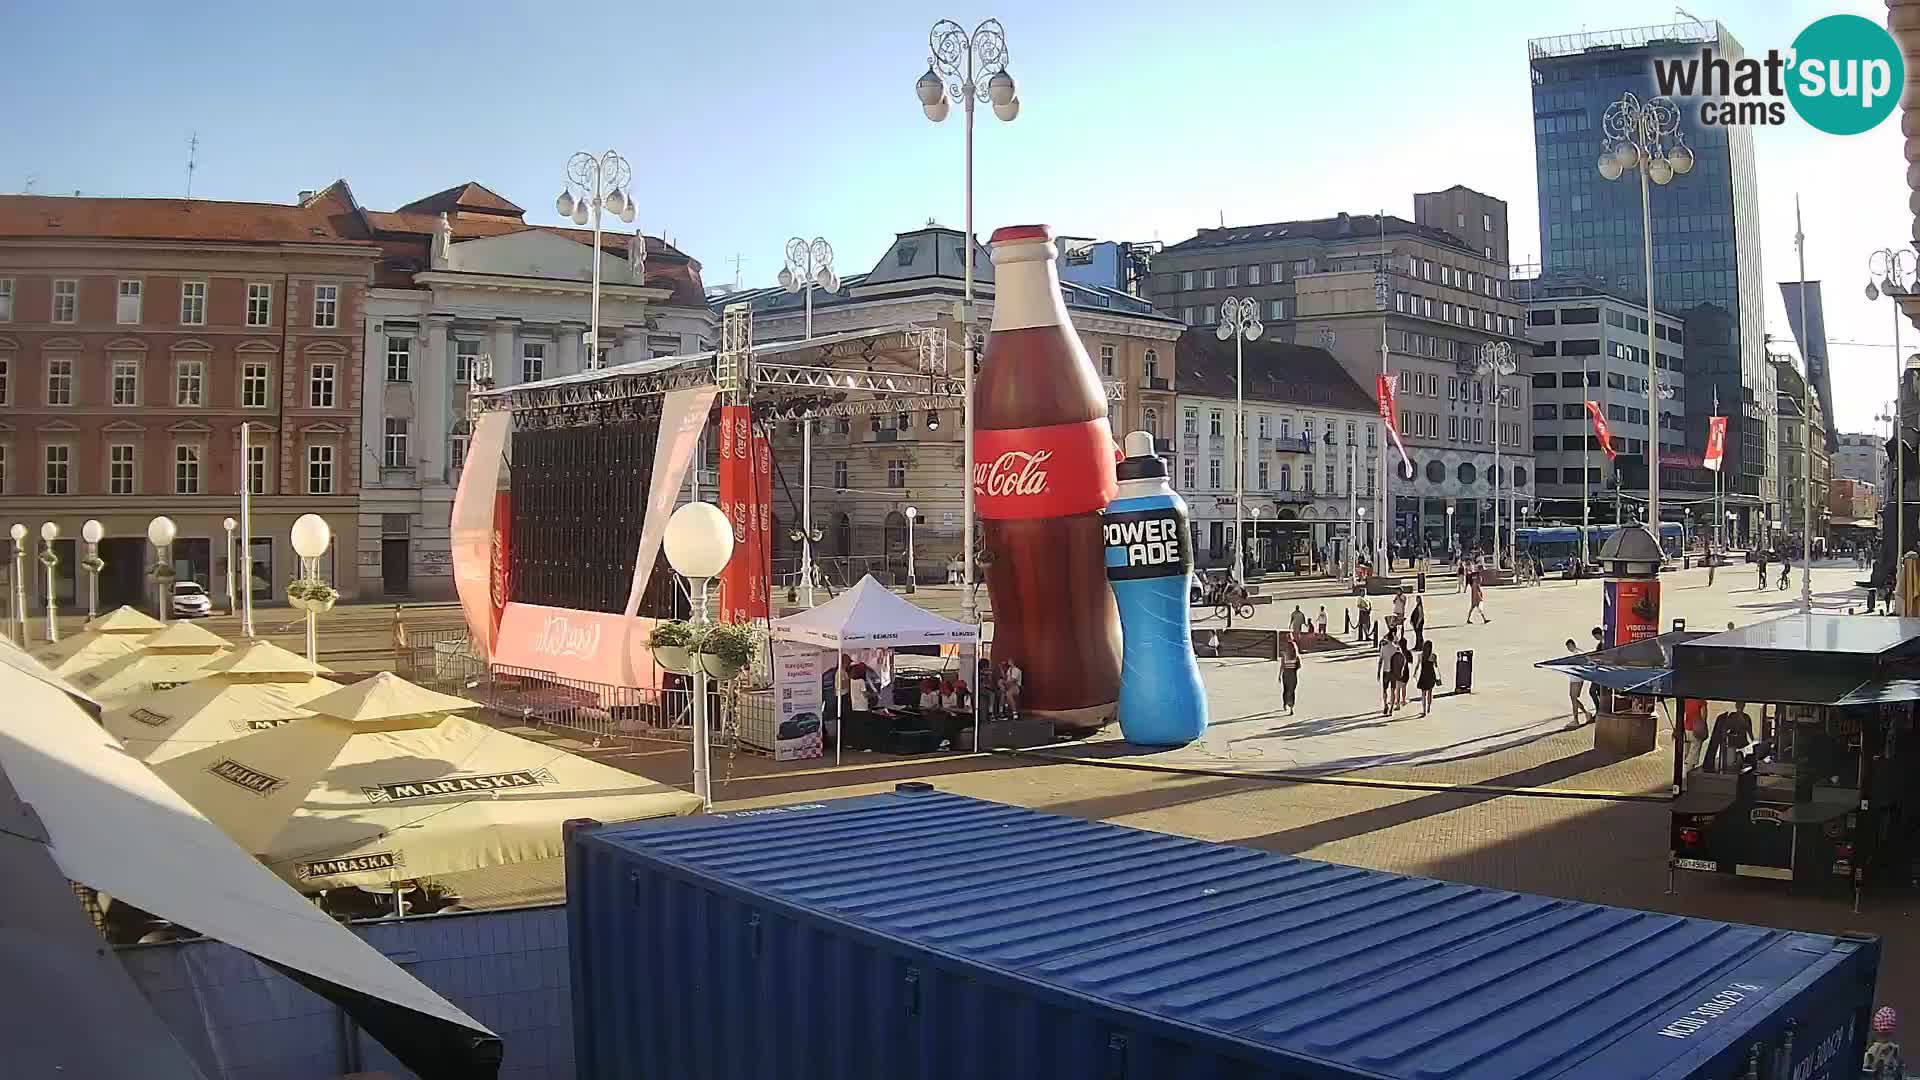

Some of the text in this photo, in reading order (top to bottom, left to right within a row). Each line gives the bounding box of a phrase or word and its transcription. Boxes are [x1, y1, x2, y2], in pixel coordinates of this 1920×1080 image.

[1103, 518, 1178, 546] POWER
[1129, 540, 1180, 567] ADE
[393, 773, 530, 799] MARASKA
[313, 854, 392, 875] MARASKA
[1690, 989, 1745, 1018] 300629
